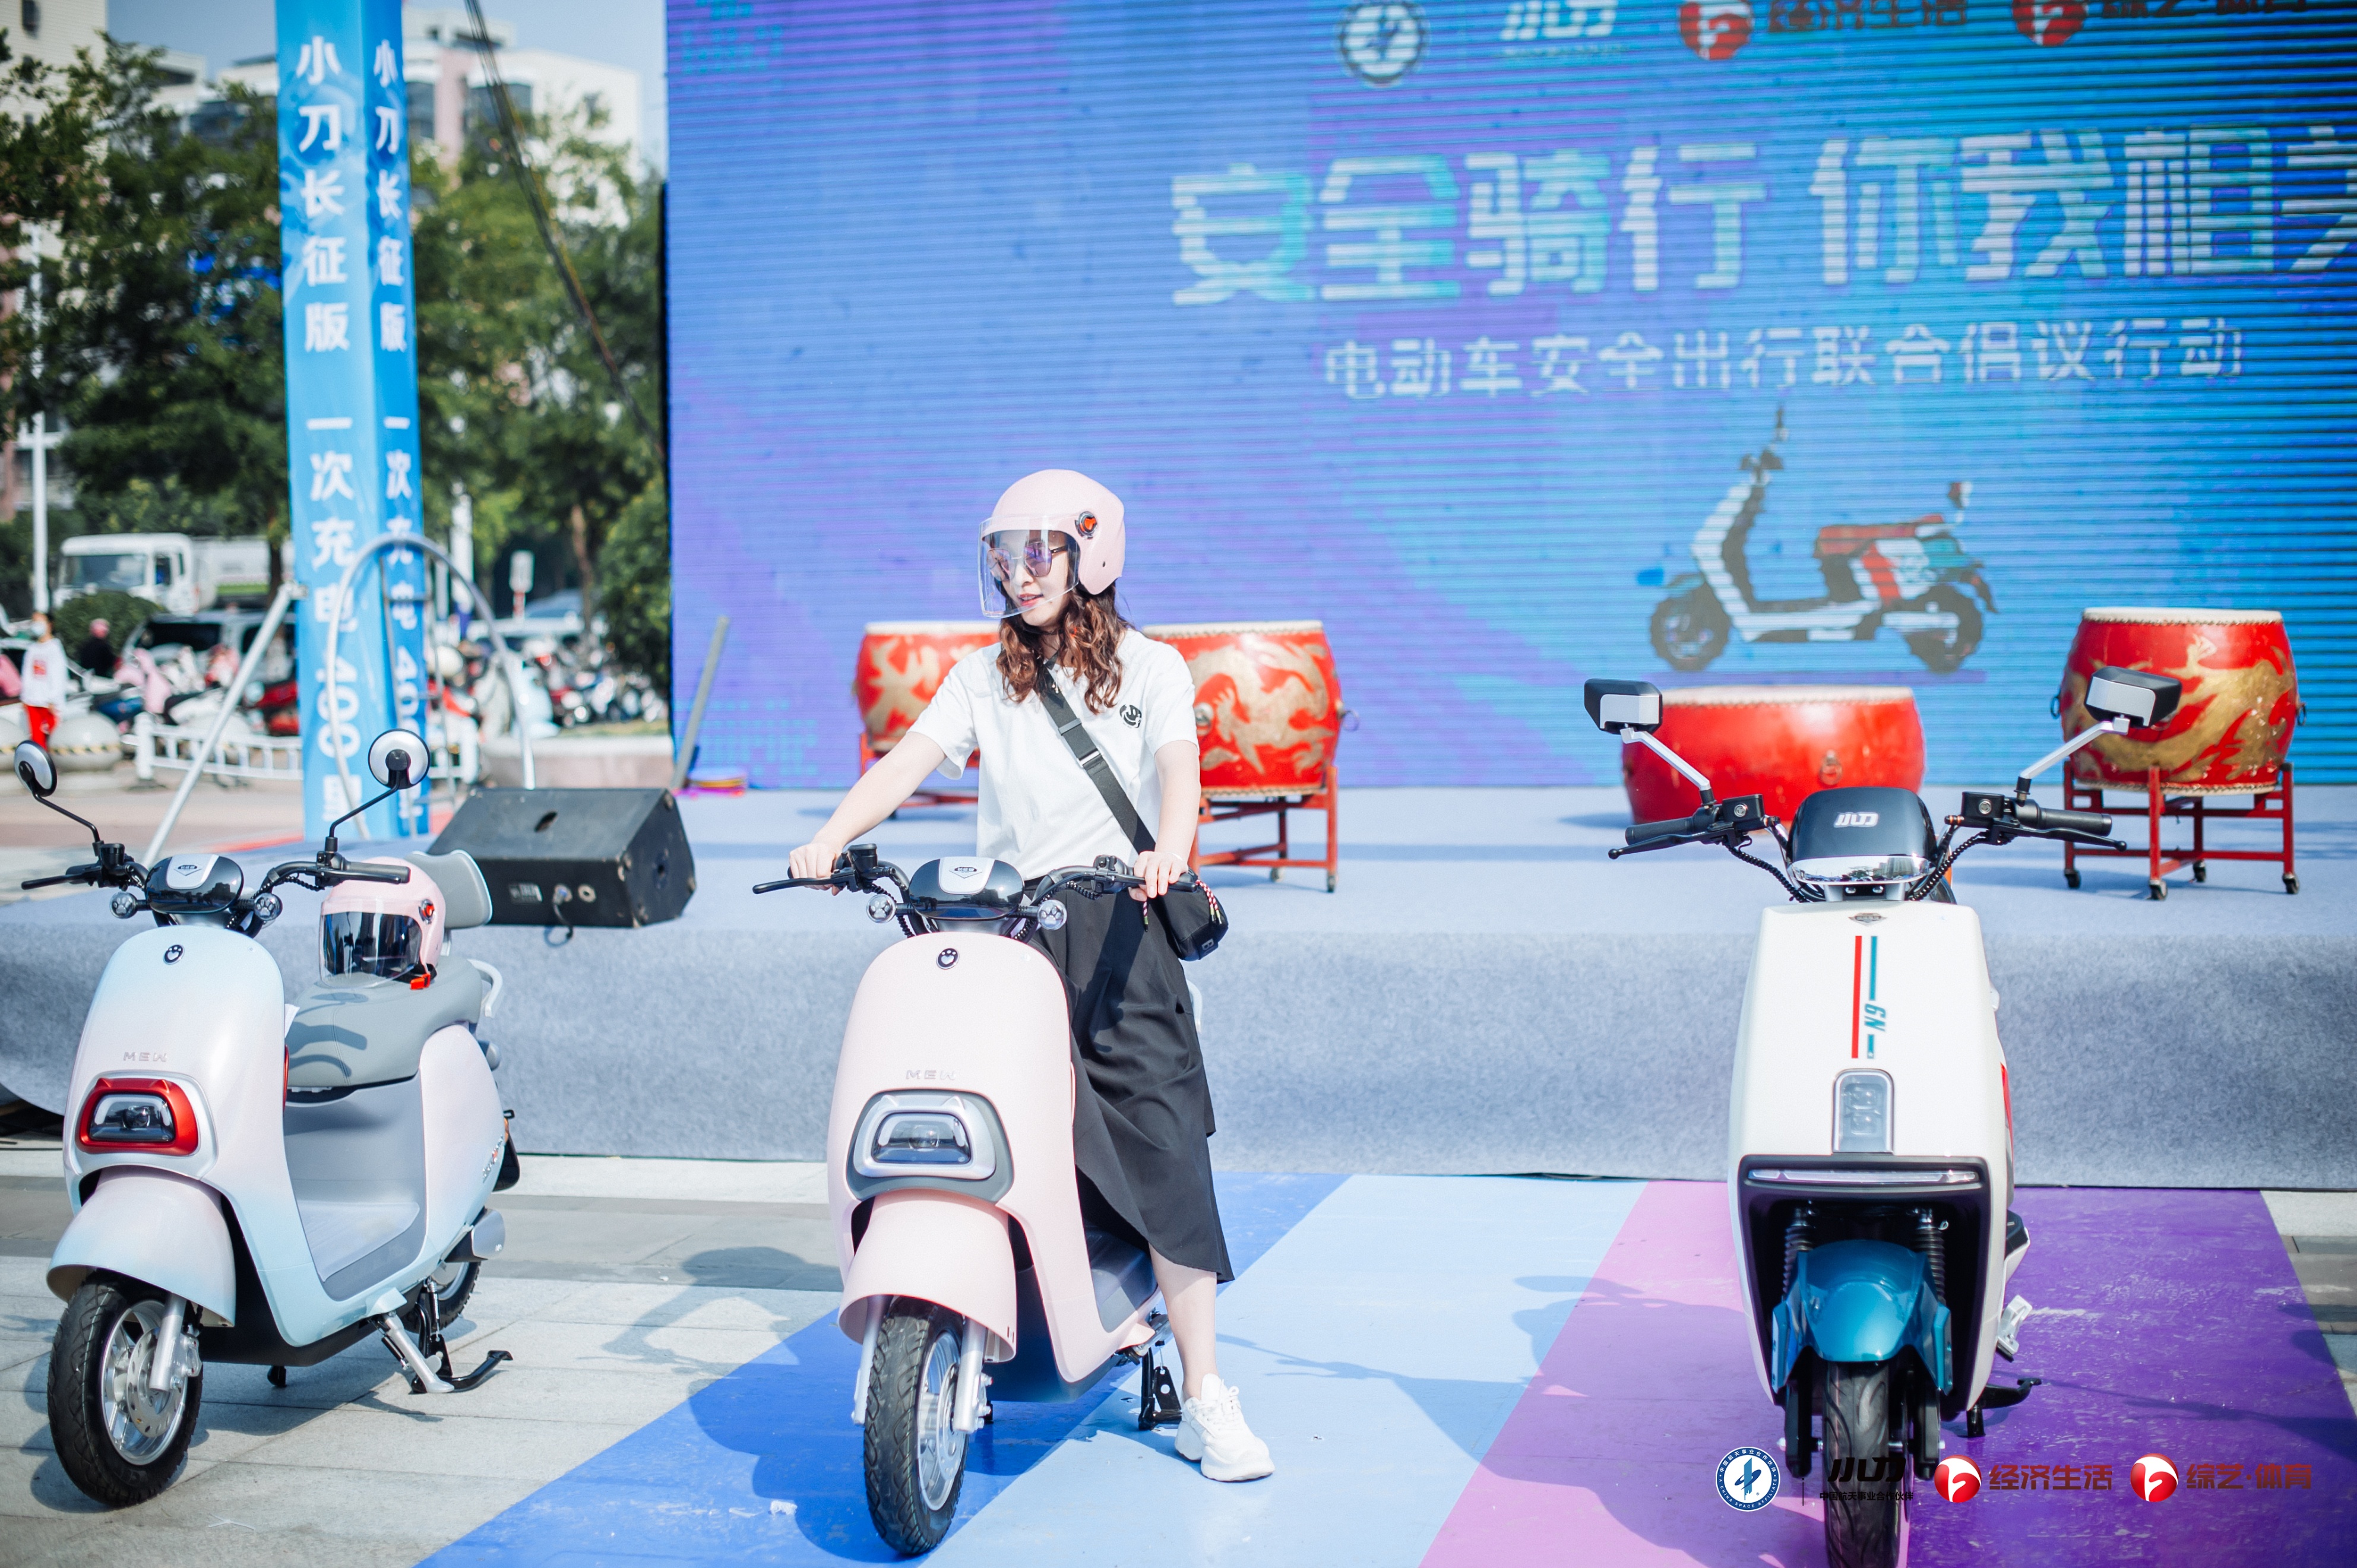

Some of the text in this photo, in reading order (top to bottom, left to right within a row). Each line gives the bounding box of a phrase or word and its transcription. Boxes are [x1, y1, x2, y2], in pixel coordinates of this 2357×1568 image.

[296, 35, 350, 353] 小刀长征版
[373, 39, 408, 352] 小刀长征版
[1172, 146, 1767, 305] 安全骑行
[1325, 317, 2244, 400] 电动车安全出行联合倡议行动
[123, 1051, 167, 1062] MEW
[1864, 1003, 1886, 1032] N9
[906, 1069, 956, 1081] MEW
